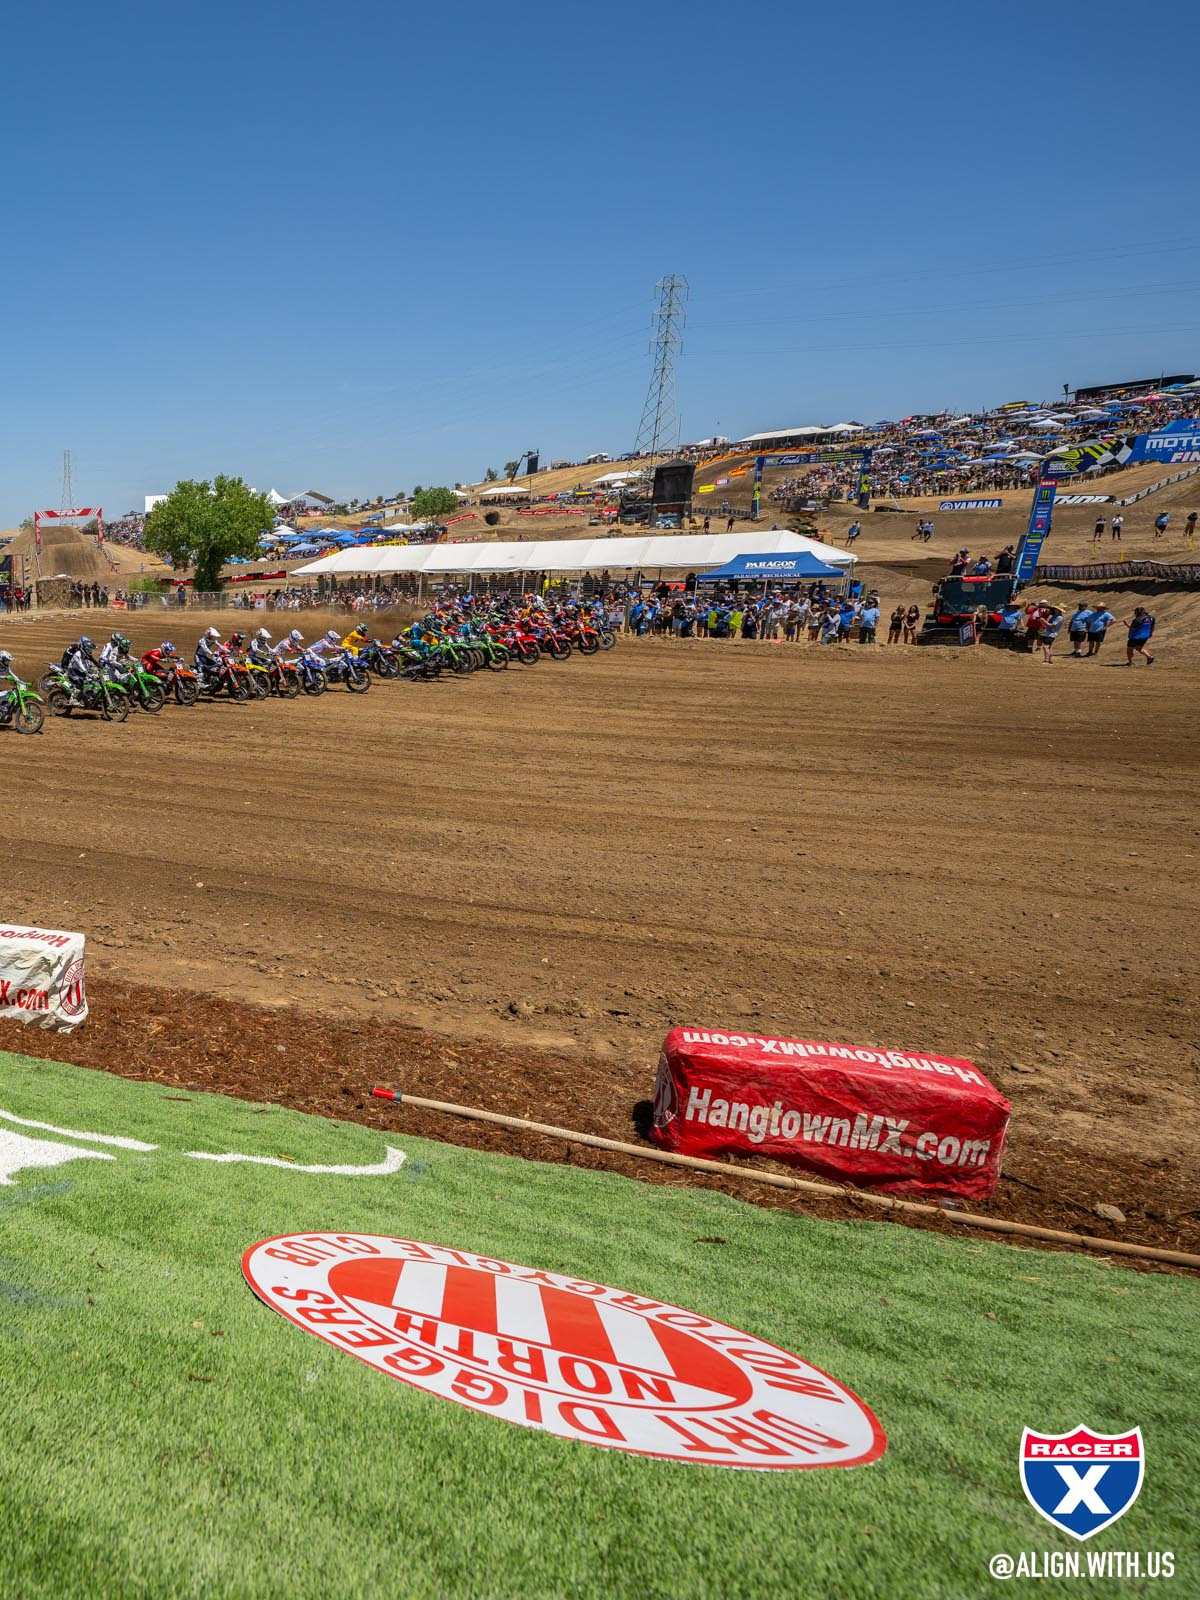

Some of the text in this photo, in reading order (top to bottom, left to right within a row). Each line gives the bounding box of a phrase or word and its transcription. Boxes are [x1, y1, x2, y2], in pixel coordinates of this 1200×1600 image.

[954, 499, 1000, 510] YAMAHA
[745, 560, 797, 568] PARAGON
[683, 1031, 986, 1087] HangtownMX.com
[685, 1086, 991, 1167] HangtownMX.com
[264, 1236, 846, 1405] MOTORCYCLE CLUB
[393, 1311, 671, 1403] NORTH
[272, 1285, 851, 1457] DIRT DIGGERS
